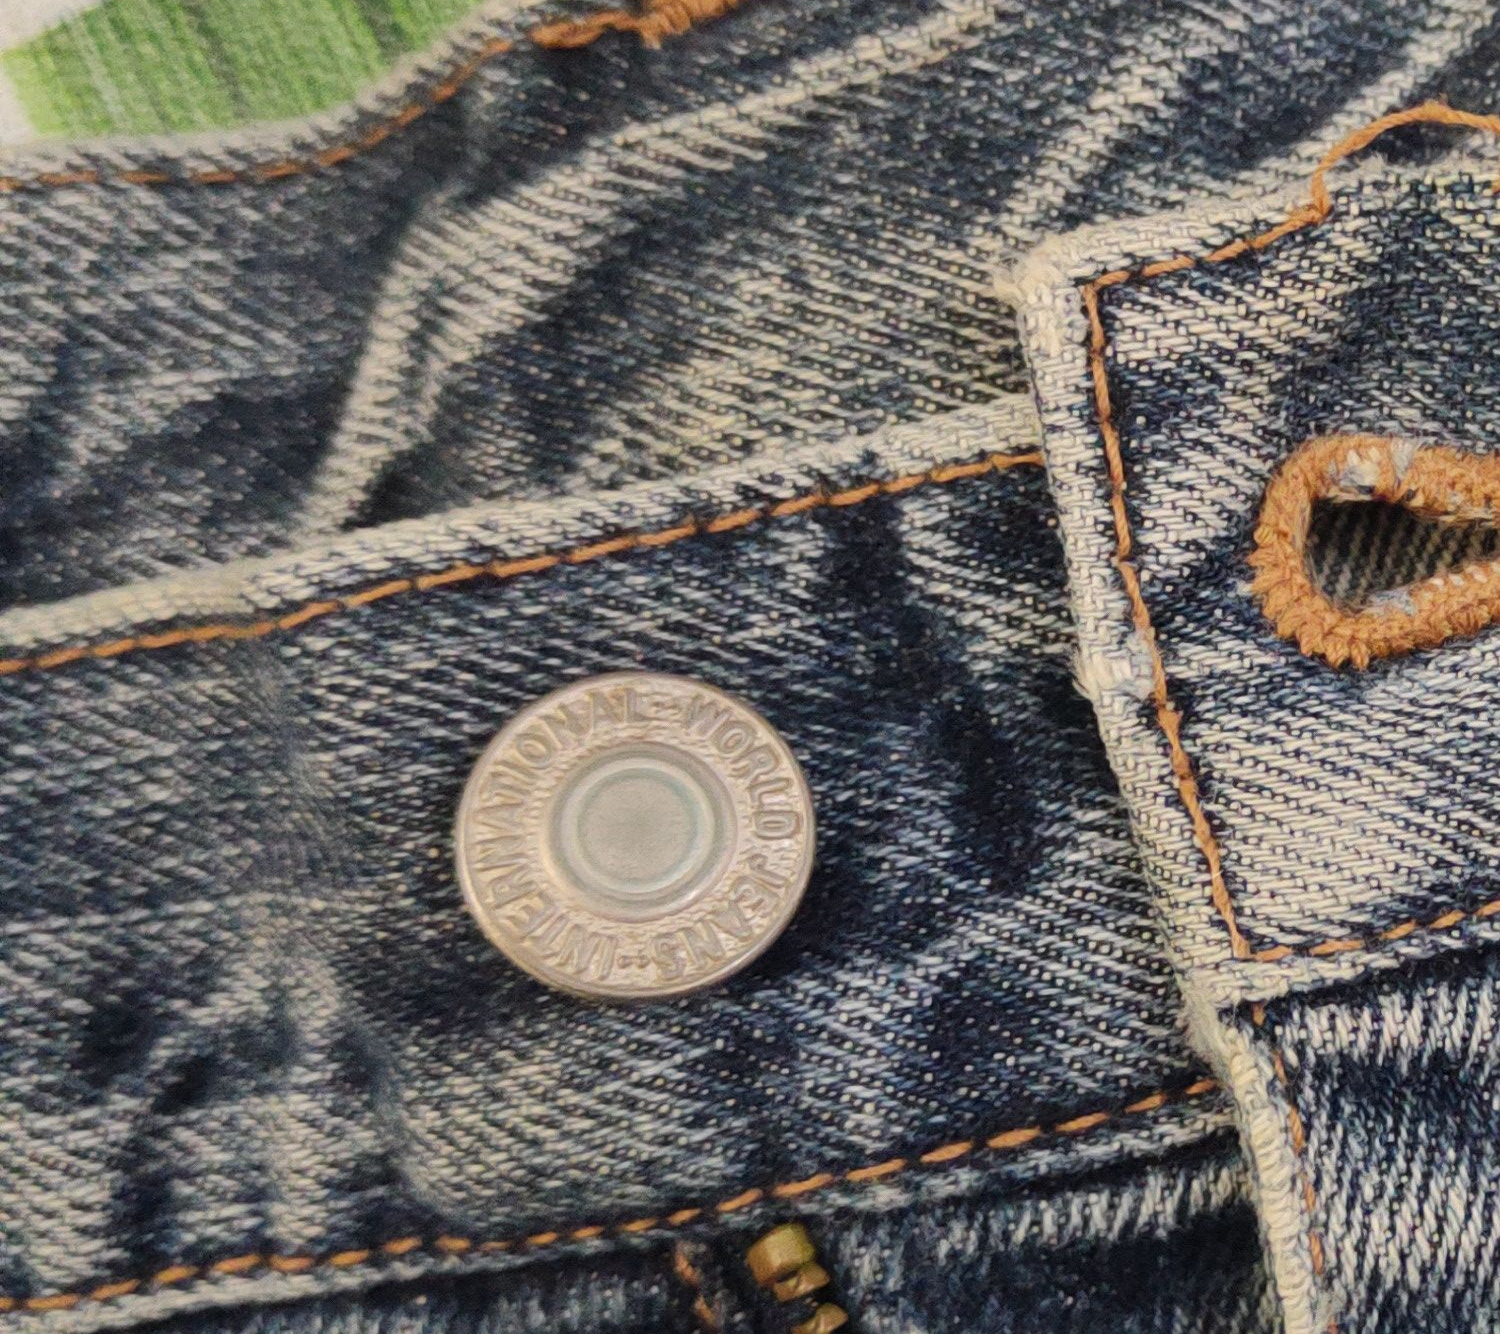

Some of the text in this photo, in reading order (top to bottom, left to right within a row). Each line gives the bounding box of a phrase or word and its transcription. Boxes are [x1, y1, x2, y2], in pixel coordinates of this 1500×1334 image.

[474, 687, 802, 980] WORLD JEANS INTERNATIONAL
